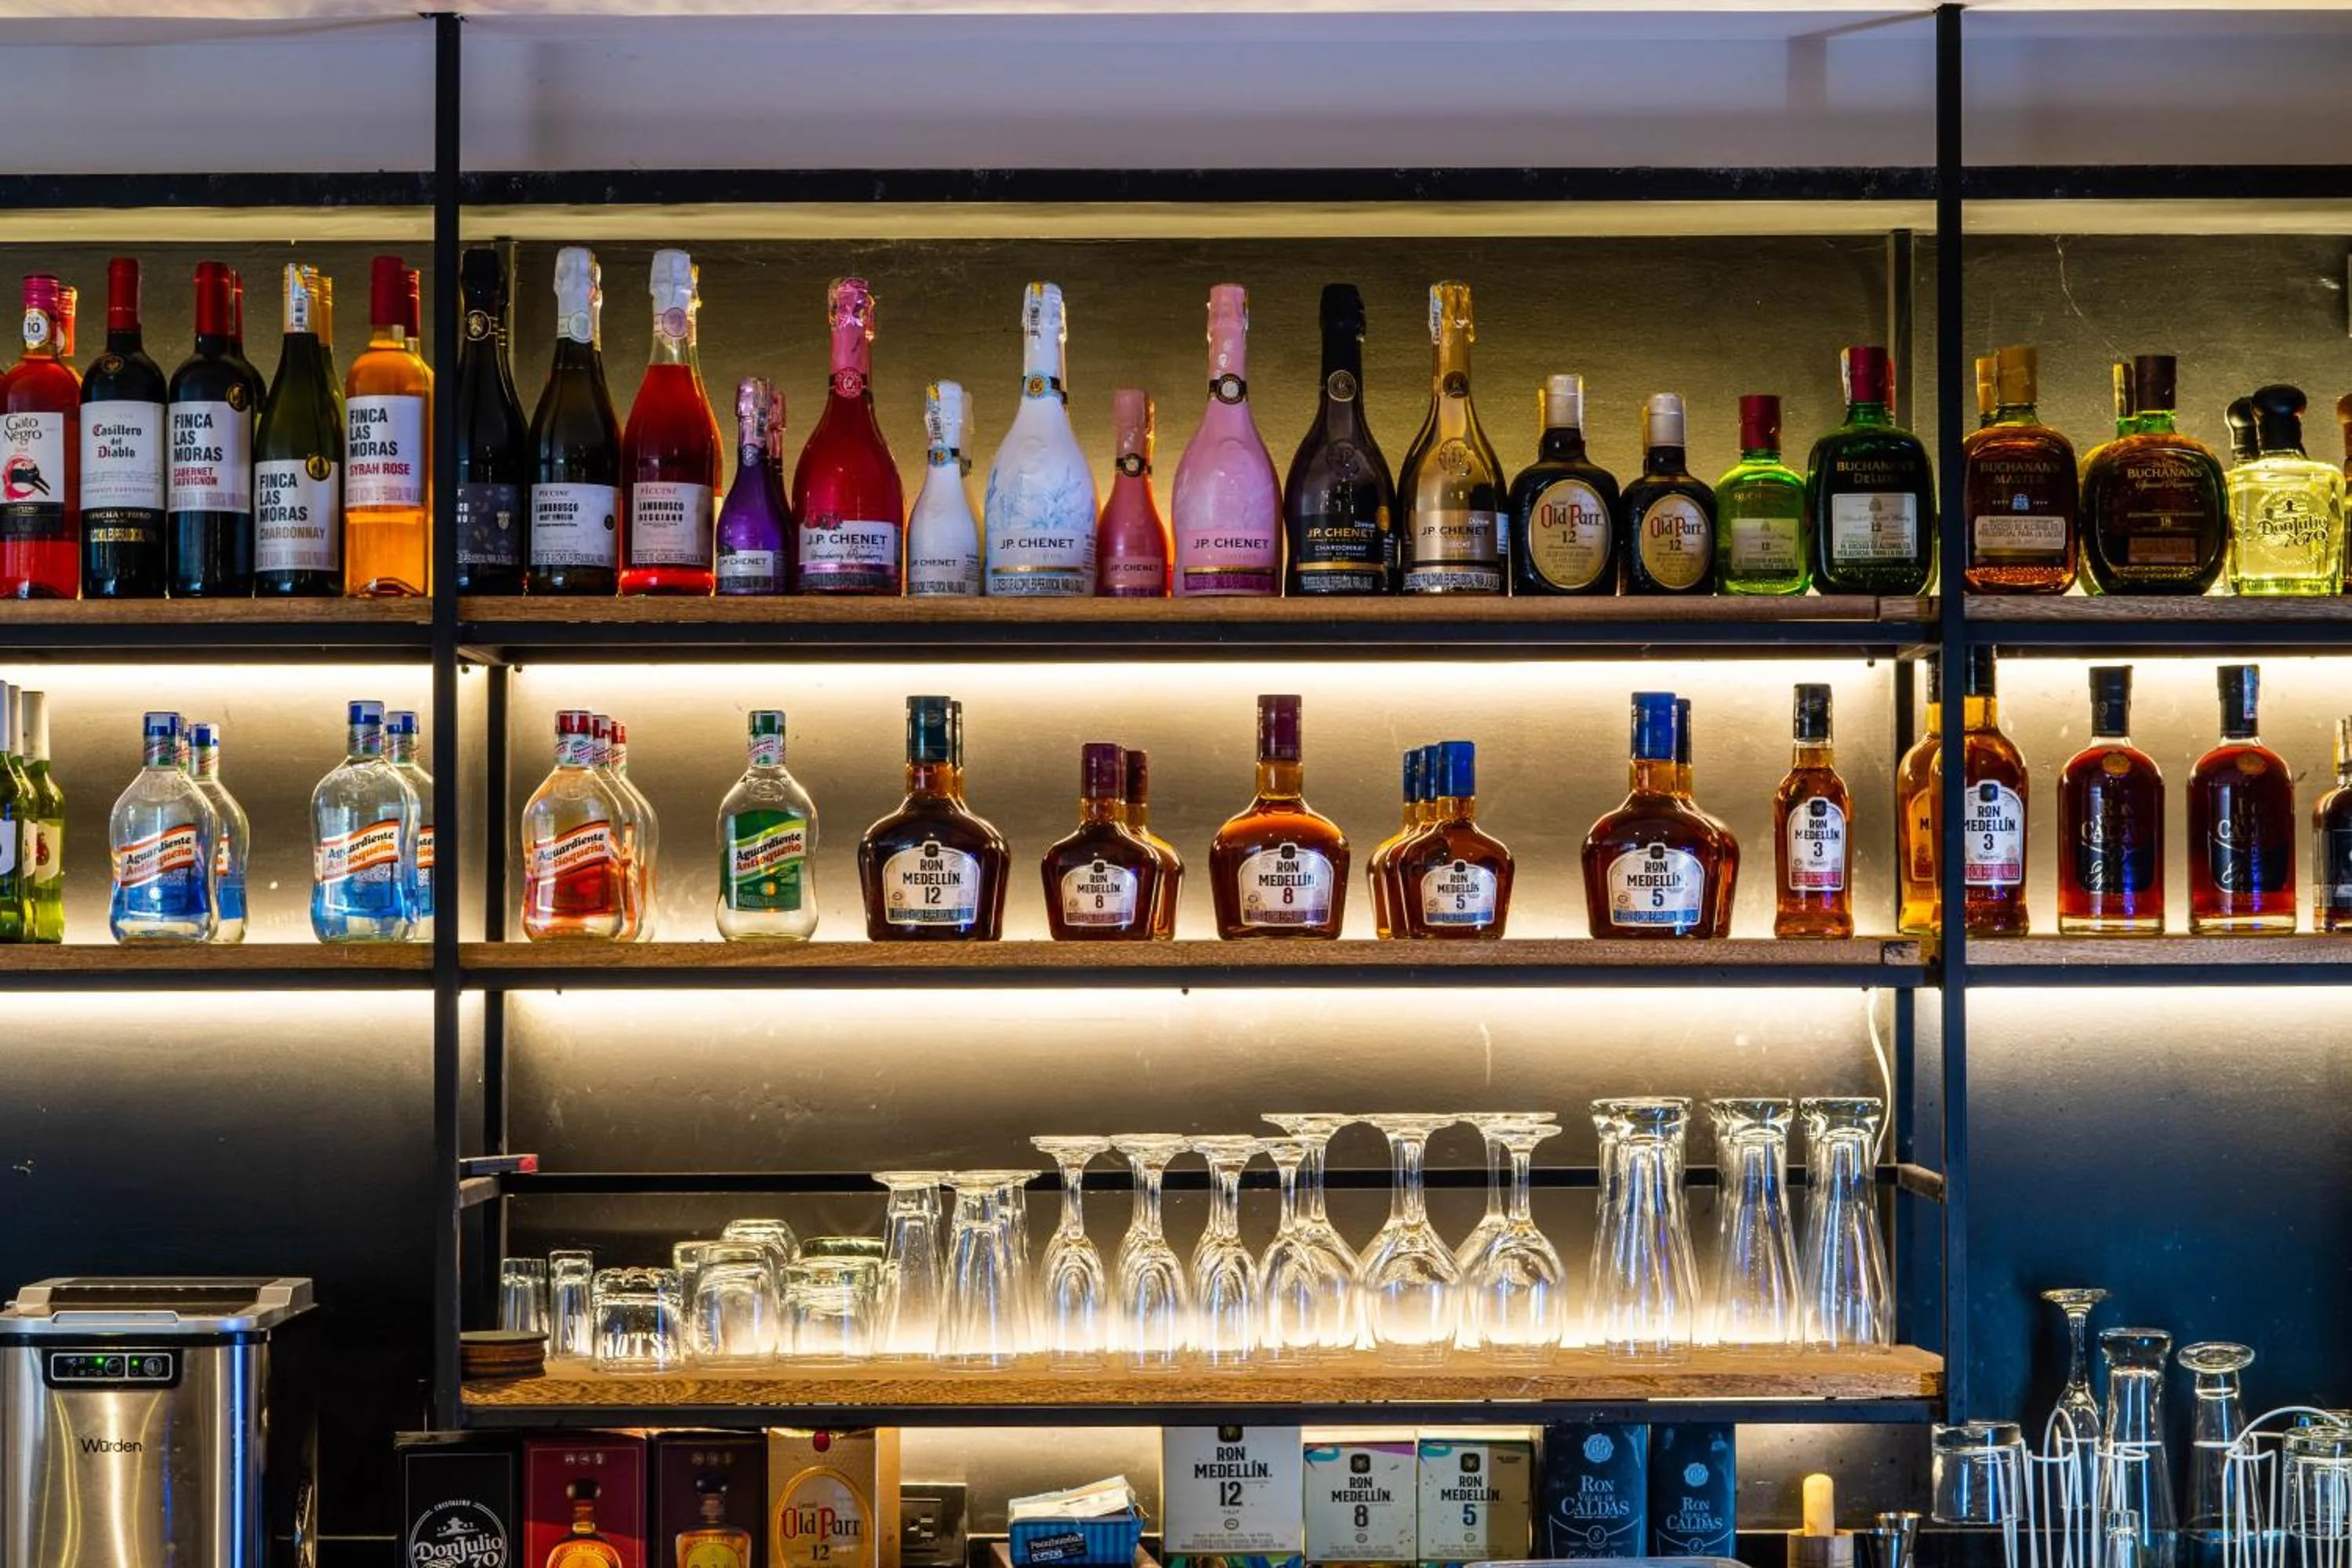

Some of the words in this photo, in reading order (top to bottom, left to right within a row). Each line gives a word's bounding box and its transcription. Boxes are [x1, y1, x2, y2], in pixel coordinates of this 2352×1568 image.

[27, 321, 41, 333] 10
[5, 415, 38, 431] Gato
[173, 413, 213, 429] FINCA
[350, 408, 388, 424] FINCA
[3, 430, 42, 446] Negro
[93, 424, 143, 437] Casillero
[350, 425, 371, 441] LAS
[173, 431, 195, 446] LAS
[98, 445, 136, 459] Diablo
[173, 446, 223, 463] MORAS
[350, 440, 397, 458] MORAS
[174, 467, 214, 477] CABERNET
[350, 463, 379, 477] SYRAH
[260, 473, 298, 489] FINCA
[260, 490, 281, 506] LAS
[639, 501, 684, 511] LAMBRUSCO
[260, 506, 308, 522] MORAS
[1541, 504, 1566, 528] Old
[1568, 504, 1602, 528] Parr
[260, 526, 325, 540] CHARDONNAY
[1324, 528, 1376, 538] CHENET
[1439, 526, 1490, 536] CHENET
[1650, 517, 1672, 539] Old
[1674, 517, 1704, 539] Parr
[1870, 521, 1883, 532] 12
[829, 534, 888, 545] CHENET
[1018, 538, 1075, 549] CHENET
[1214, 538, 1269, 549] CHENET
[1562, 531, 1577, 543] 12
[1669, 539, 1682, 551] 12
[1123, 564, 1159, 572] CHENET
[1977, 806, 2000, 817] RON
[1809, 819, 1828, 829] RON
[1965, 816, 2016, 832] MEDELLÍN
[1795, 829, 1840, 840] MEDELLÍN
[1984, 833, 1994, 850] 3
[736, 833, 802, 861] Aguardiente
[1813, 842, 1824, 857] 3
[736, 843, 802, 872] Antioqueño
[920, 859, 943, 871] RON
[1276, 861, 1299, 873] RON
[1644, 861, 1668, 873] RON
[902, 869, 960, 885] MEDELLÍN
[1089, 874, 1108, 883] RON
[1258, 871, 1316, 887] MEDELLÍN
[1450, 874, 1468, 883] RON
[924, 887, 942, 904] 12
[1076, 883, 1120, 894] MEDELLÍN
[1283, 887, 1294, 904] 8
[1437, 882, 1479, 894] MEDELLÍN
[1095, 895, 1104, 909] 8
[1456, 895, 1465, 909] 5
[1652, 888, 1664, 907] 5
[1217, 1446, 1246, 1461] RON
[1194, 1460, 1268, 1479] MEDELLÍN
[1348, 1476, 1372, 1488] RON
[1459, 1475, 1482, 1487] RON
[1220, 1481, 1243, 1506] 12
[1331, 1487, 1391, 1502] MEDELLÍN
[1441, 1486, 1501, 1501] MEDELLÍN
[1562, 1497, 1630, 1515] CALDAS
[1354, 1504, 1368, 1527] 8
[1462, 1504, 1476, 1526] 5
[1666, 1514, 1724, 1530] CALDAS
[781, 1508, 815, 1539] Old
[817, 1507, 859, 1541] Parr
[1593, 1529, 1601, 1541] 8
[812, 1544, 830, 1560] 12
[470, 1552, 499, 1568] 70
